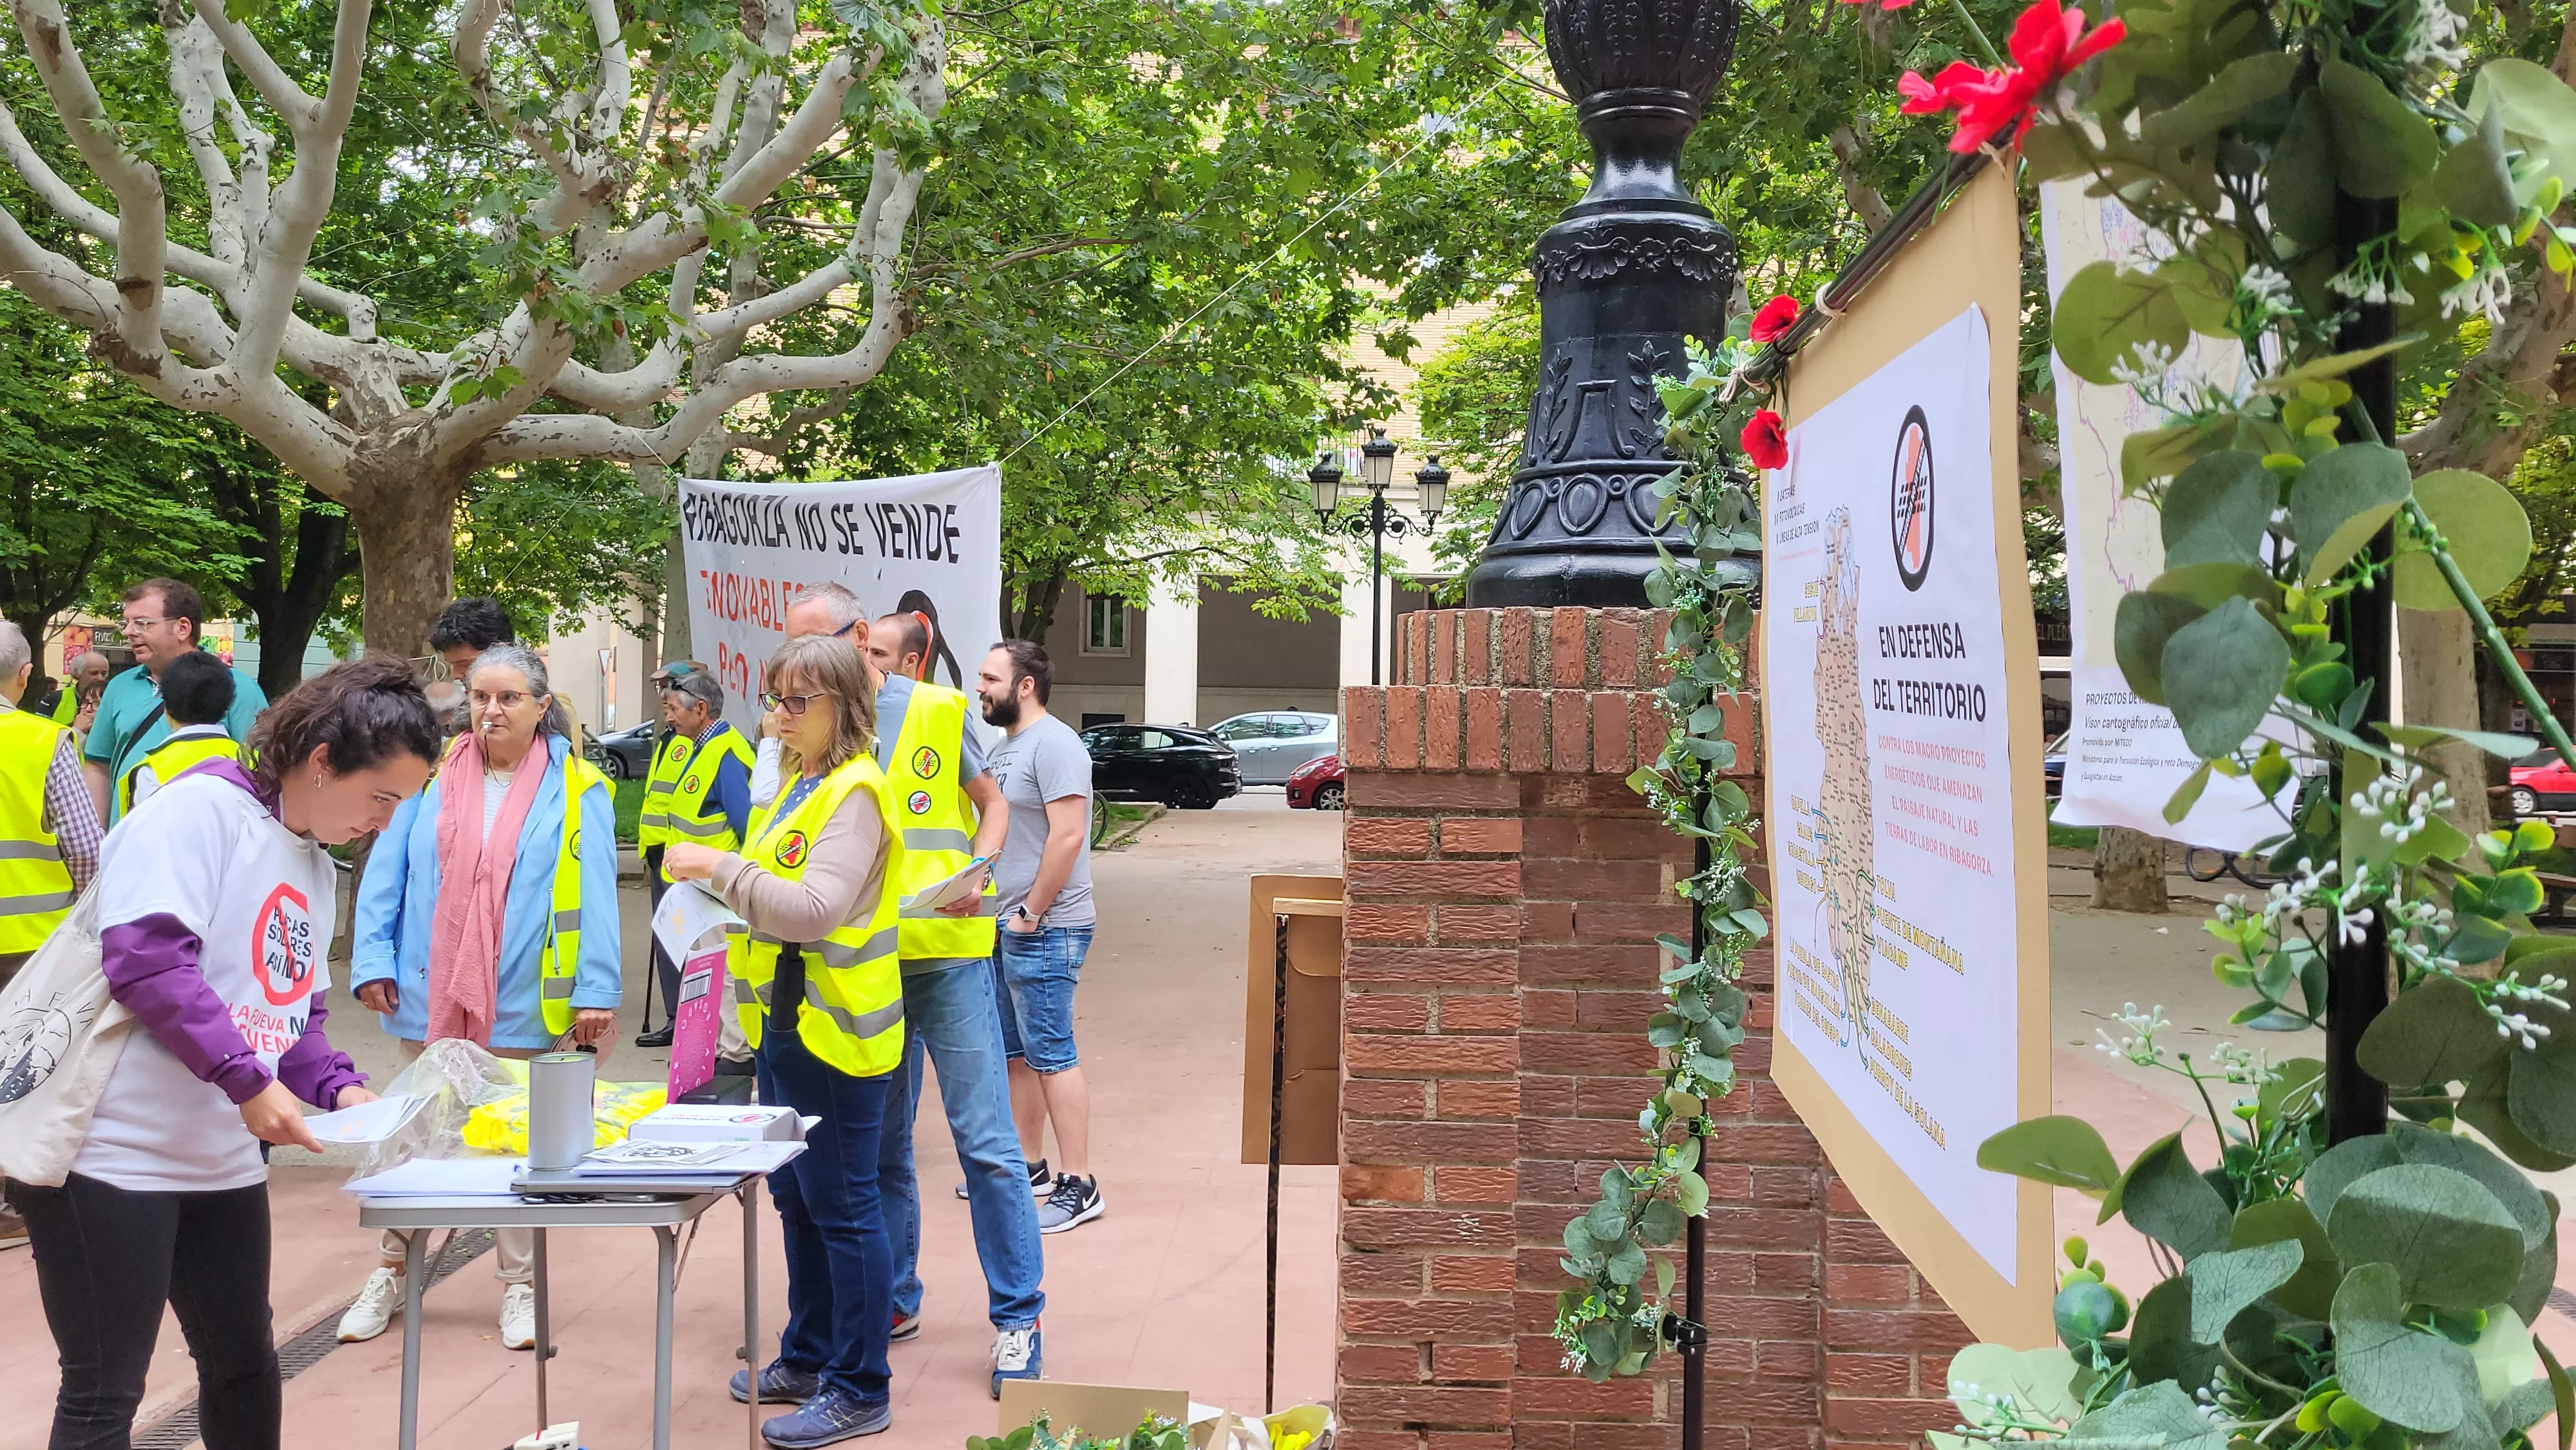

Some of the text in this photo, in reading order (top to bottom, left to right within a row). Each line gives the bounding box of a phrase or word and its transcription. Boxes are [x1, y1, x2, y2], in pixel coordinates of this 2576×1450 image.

[795, 502, 827, 552] NO
[831, 504, 864, 556] SE
[864, 504, 961, 563] VENDE
[1879, 623, 1966, 659] EN DEFENSA
[1873, 679, 1986, 722] DEL TERRITORIO
[2086, 692, 2127, 706] PROYECTOS
[2129, 693, 2137, 704] DE
[2085, 716, 2101, 729] Visor
[2102, 715, 2148, 733] cartográfico
[2150, 715, 2172, 729] oficial
[1879, 735, 1986, 769] CONTRA LOS MACRO PROYECTOS
[1884, 765, 1983, 804] ENERGÉTICOS QUE AMENAZAN
[1892, 796, 1978, 836] EL PAISAJE NATURAL Y LAS
[1885, 822, 1994, 878] TIERRAS DE LABOR EN RIBAGORZA.
[274, 905, 310, 937] PLACAS
[1877, 905, 1901, 936] PUENTE
[1902, 919, 1911, 943] DE
[268, 924, 312, 957] SOLARES
[265, 952, 307, 983] ASÍ NO
[227, 1003, 249, 1020] LA
[250, 1008, 285, 1033] FUEVA
[1895, 1082, 1904, 1107] DE
[1904, 1091, 1913, 1117] LA
[1915, 1102, 1946, 1151] SOLANA
